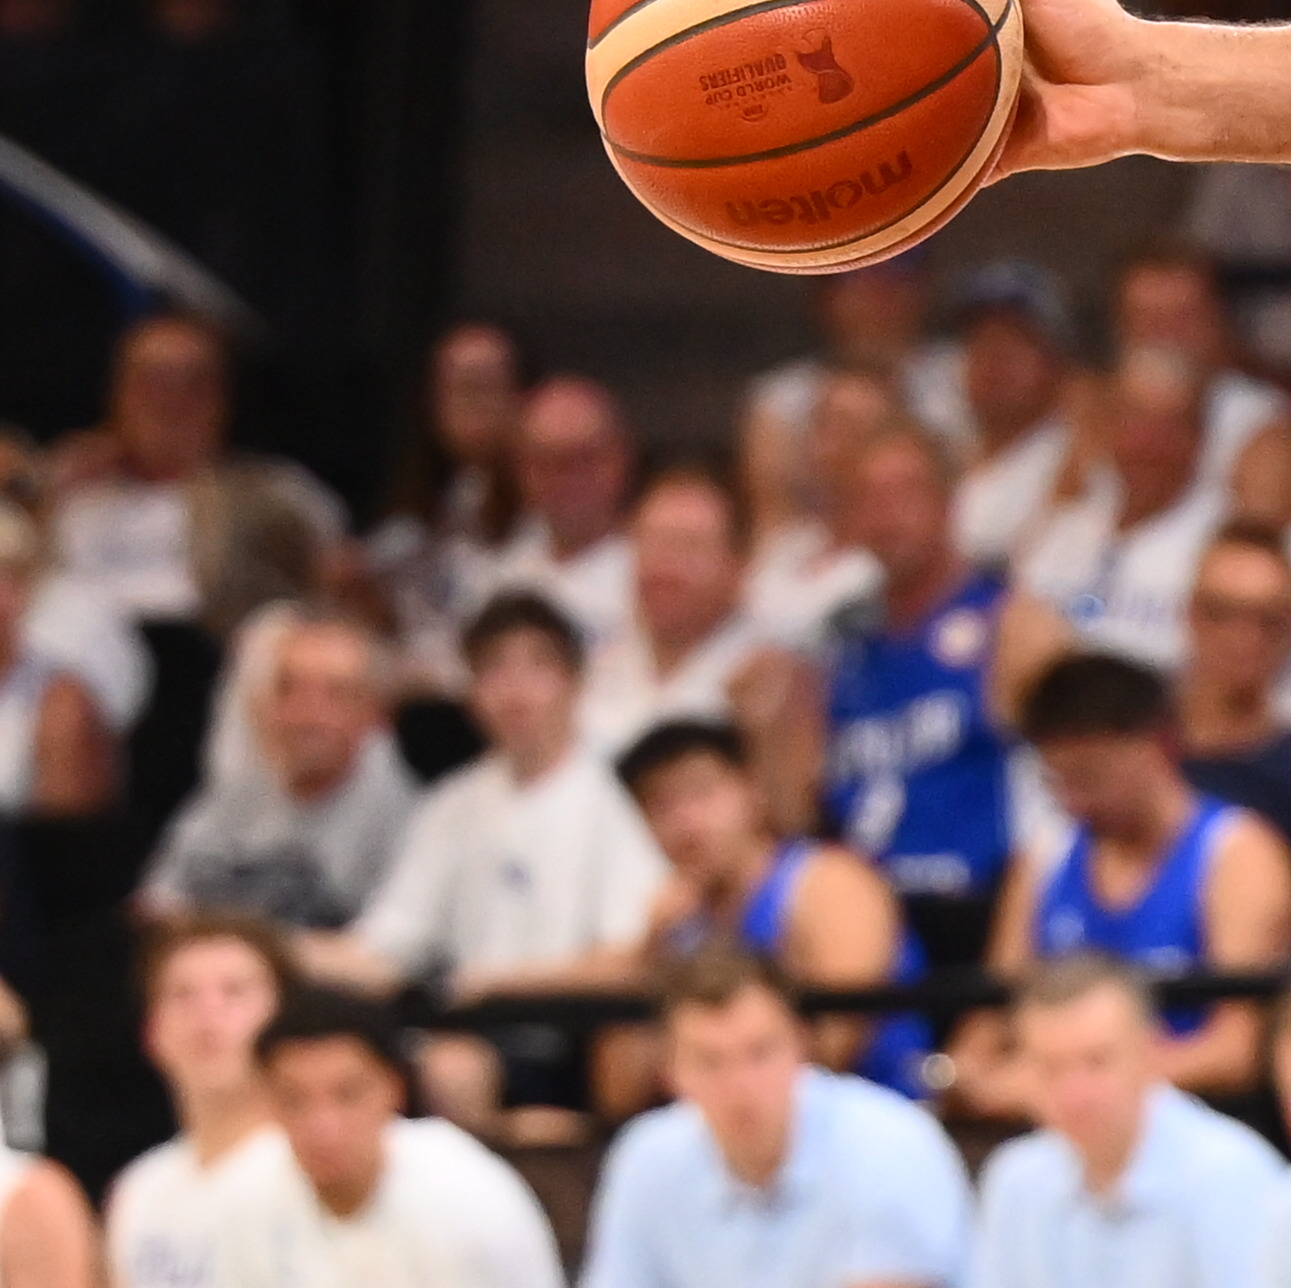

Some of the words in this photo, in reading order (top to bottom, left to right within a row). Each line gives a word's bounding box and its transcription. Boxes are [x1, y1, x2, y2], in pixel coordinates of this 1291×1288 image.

[699, 53, 787, 92] QUALIFIERS
[736, 73, 792, 97] WORLD
[705, 89, 733, 105] CUP
[724, 150, 913, 226] molten
